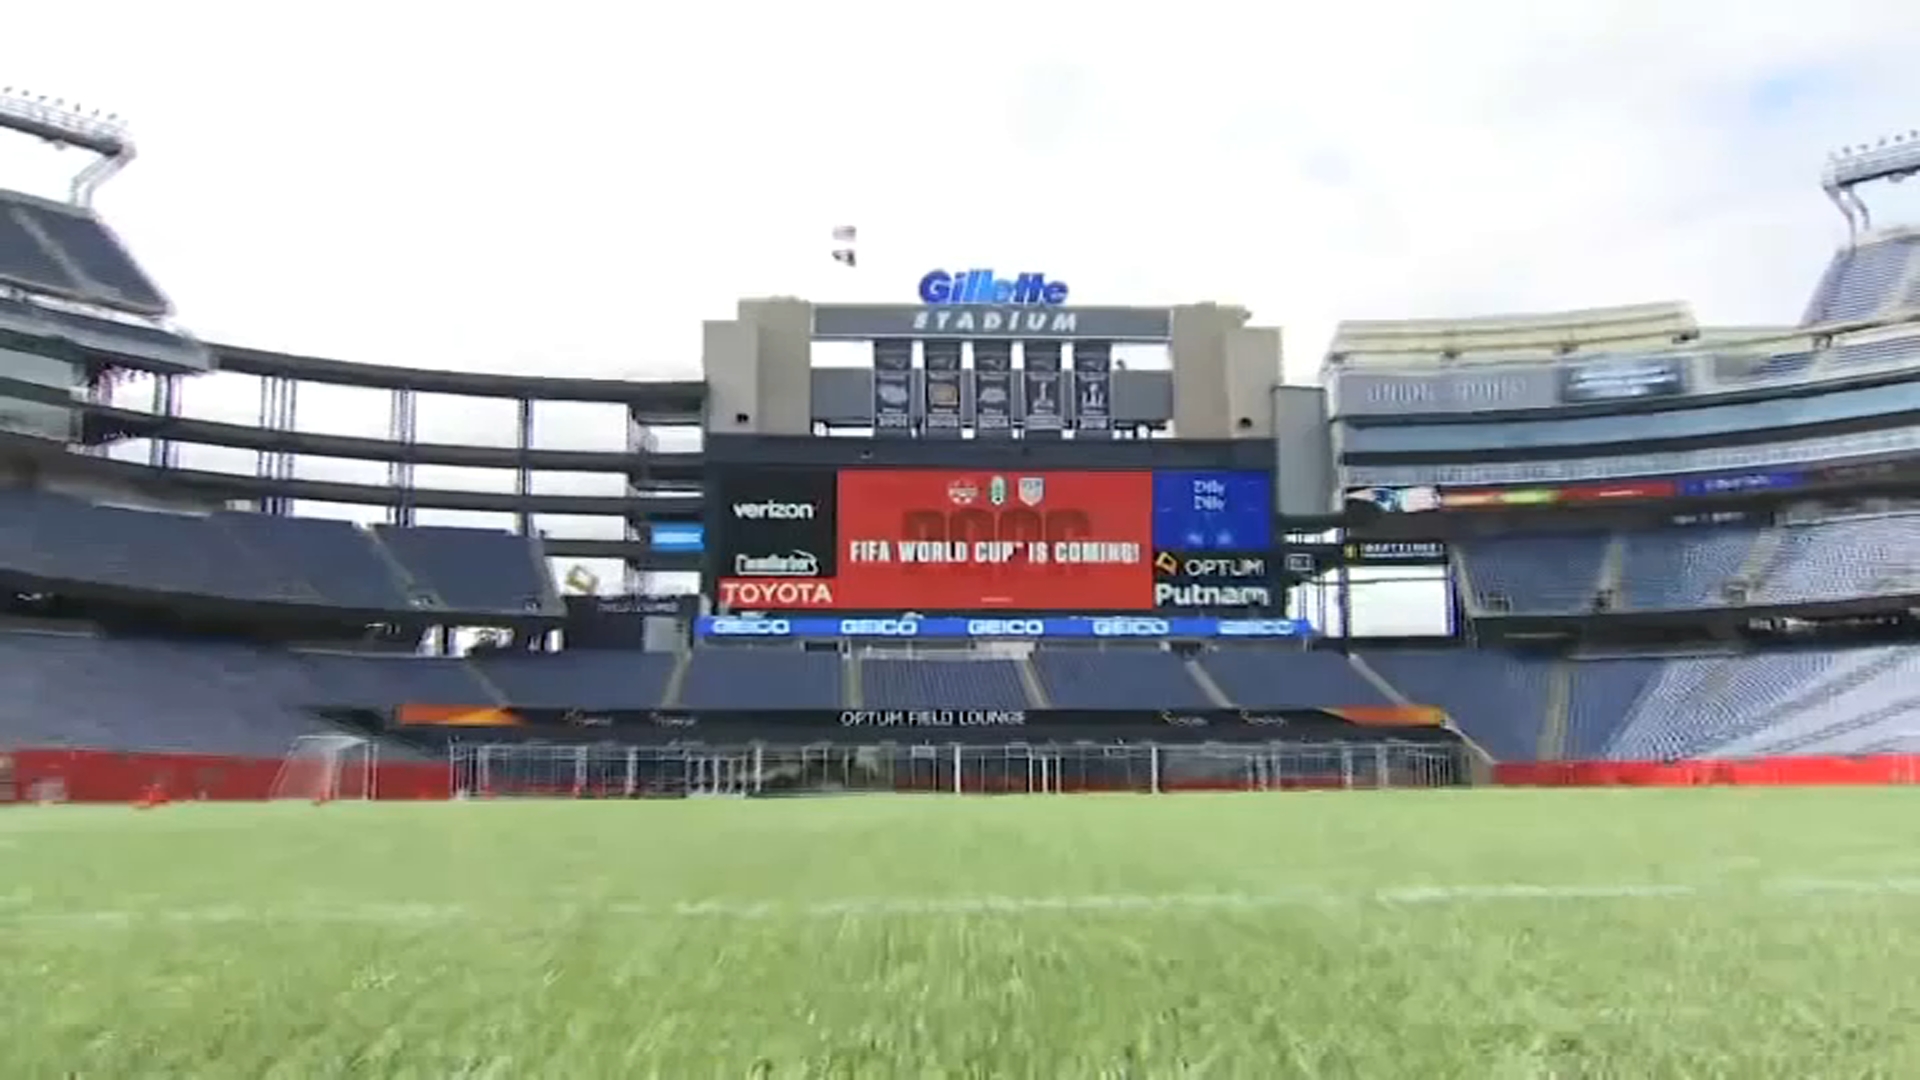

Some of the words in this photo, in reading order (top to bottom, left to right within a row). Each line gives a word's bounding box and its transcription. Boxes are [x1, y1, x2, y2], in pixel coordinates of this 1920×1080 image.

[919, 269, 1069, 303] Gillette
[913, 311, 1077, 332] STADIUM
[733, 499, 814, 518] verizon
[850, 540, 890, 563] FIFA
[898, 540, 967, 563] WORLD
[1028, 541, 1048, 563] IS
[1055, 541, 1140, 563] COMING!
[1185, 558, 1265, 577] OPTUM
[721, 583, 832, 604] TOYOTA
[1155, 583, 1270, 606] Putnam
[713, 619, 790, 635] GEICO
[841, 619, 918, 635] GEICO
[968, 619, 1043, 635] GEICO
[1093, 620, 1169, 635] GEICO
[841, 711, 901, 726] OPTUM
[909, 711, 953, 727] FIELD
[959, 711, 1026, 726] LOUNGE
